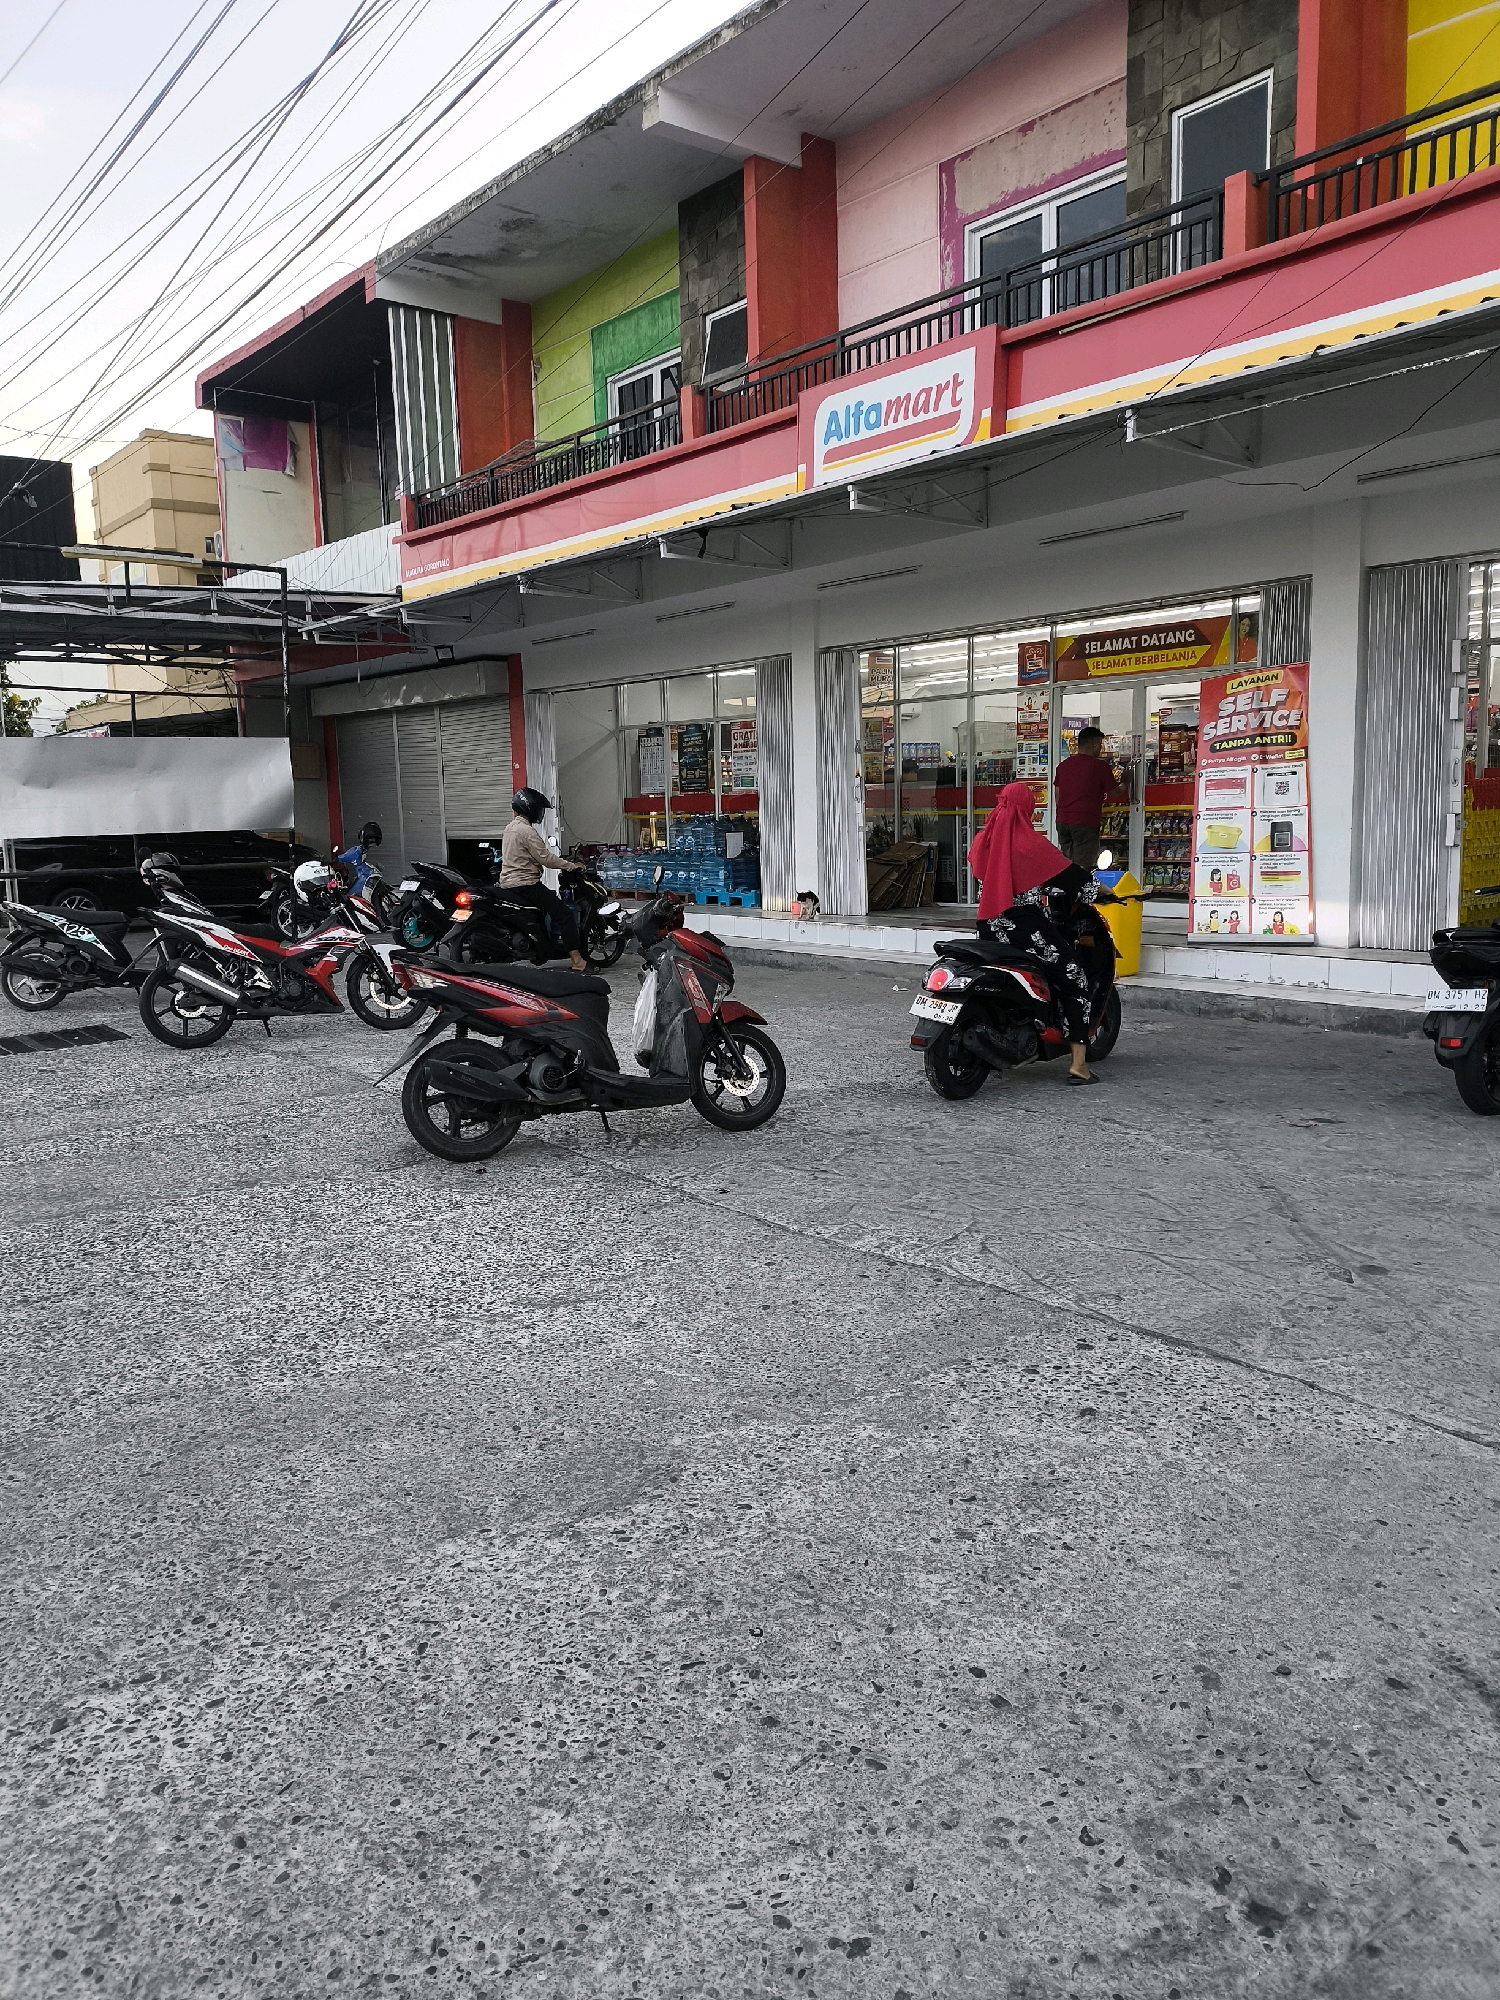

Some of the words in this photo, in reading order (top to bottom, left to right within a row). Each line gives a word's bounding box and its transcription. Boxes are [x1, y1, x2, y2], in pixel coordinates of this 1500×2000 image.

[823, 372, 964, 446] Alfamart
[423, 558, 450, 572] GORONTALO
[1085, 635, 1137, 654] SELAMAT
[1140, 629, 1196, 648] DATANG
[1091, 657, 1132, 671] SELAMAT
[1134, 650, 1198, 666] BERBELANJA
[1230, 673, 1279, 690] LAYANAN
[1218, 688, 1290, 717] SELF
[1202, 709, 1304, 741] SERVICE
[1213, 737, 1253, 750] TANPA
[1444, 990, 1468, 1000] 3751
[1474, 990, 1488, 1000] HZ
